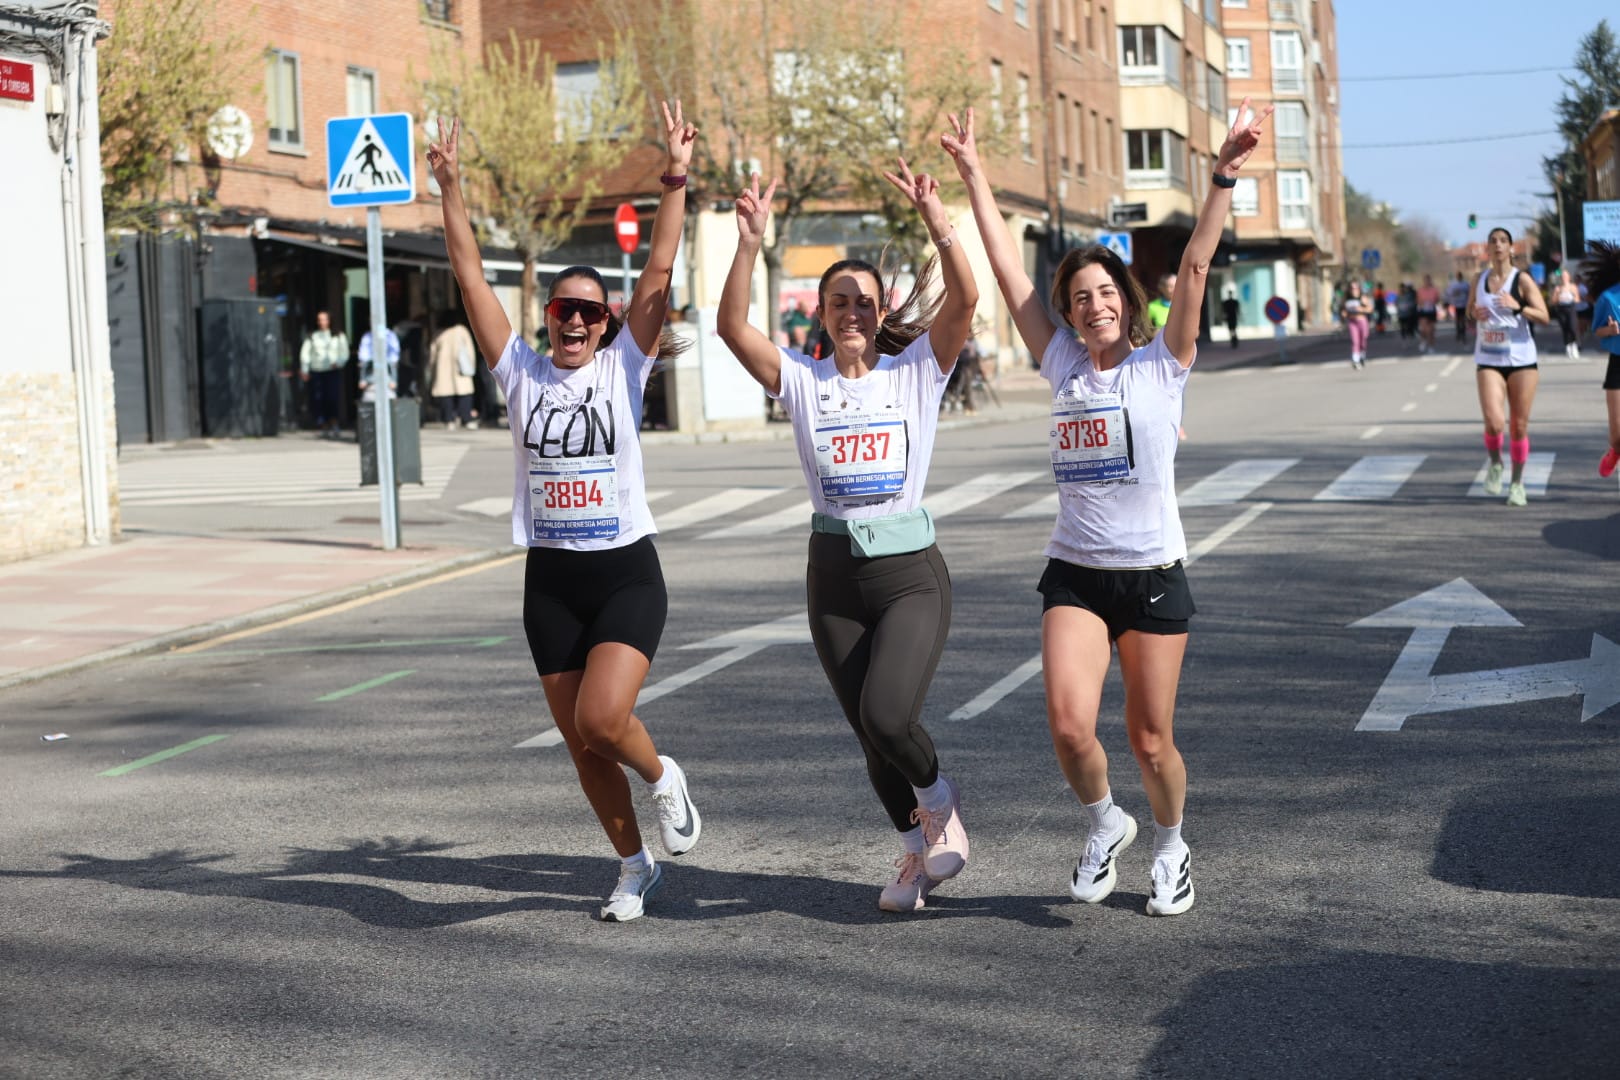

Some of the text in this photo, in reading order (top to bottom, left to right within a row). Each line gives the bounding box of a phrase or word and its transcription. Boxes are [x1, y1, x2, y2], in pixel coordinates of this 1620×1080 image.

[524, 387, 615, 458] LEÓN
[1058, 418, 1109, 450] 3738
[832, 432, 890, 464] 3737
[855, 474, 885, 483] BERNESGA
[886, 472, 904, 480] MOTOR
[1104, 459, 1126, 468] MOTOR
[543, 480, 604, 509] 3894
[566, 520, 596, 529] BERNESGA
[596, 519, 617, 527] MOTOR
